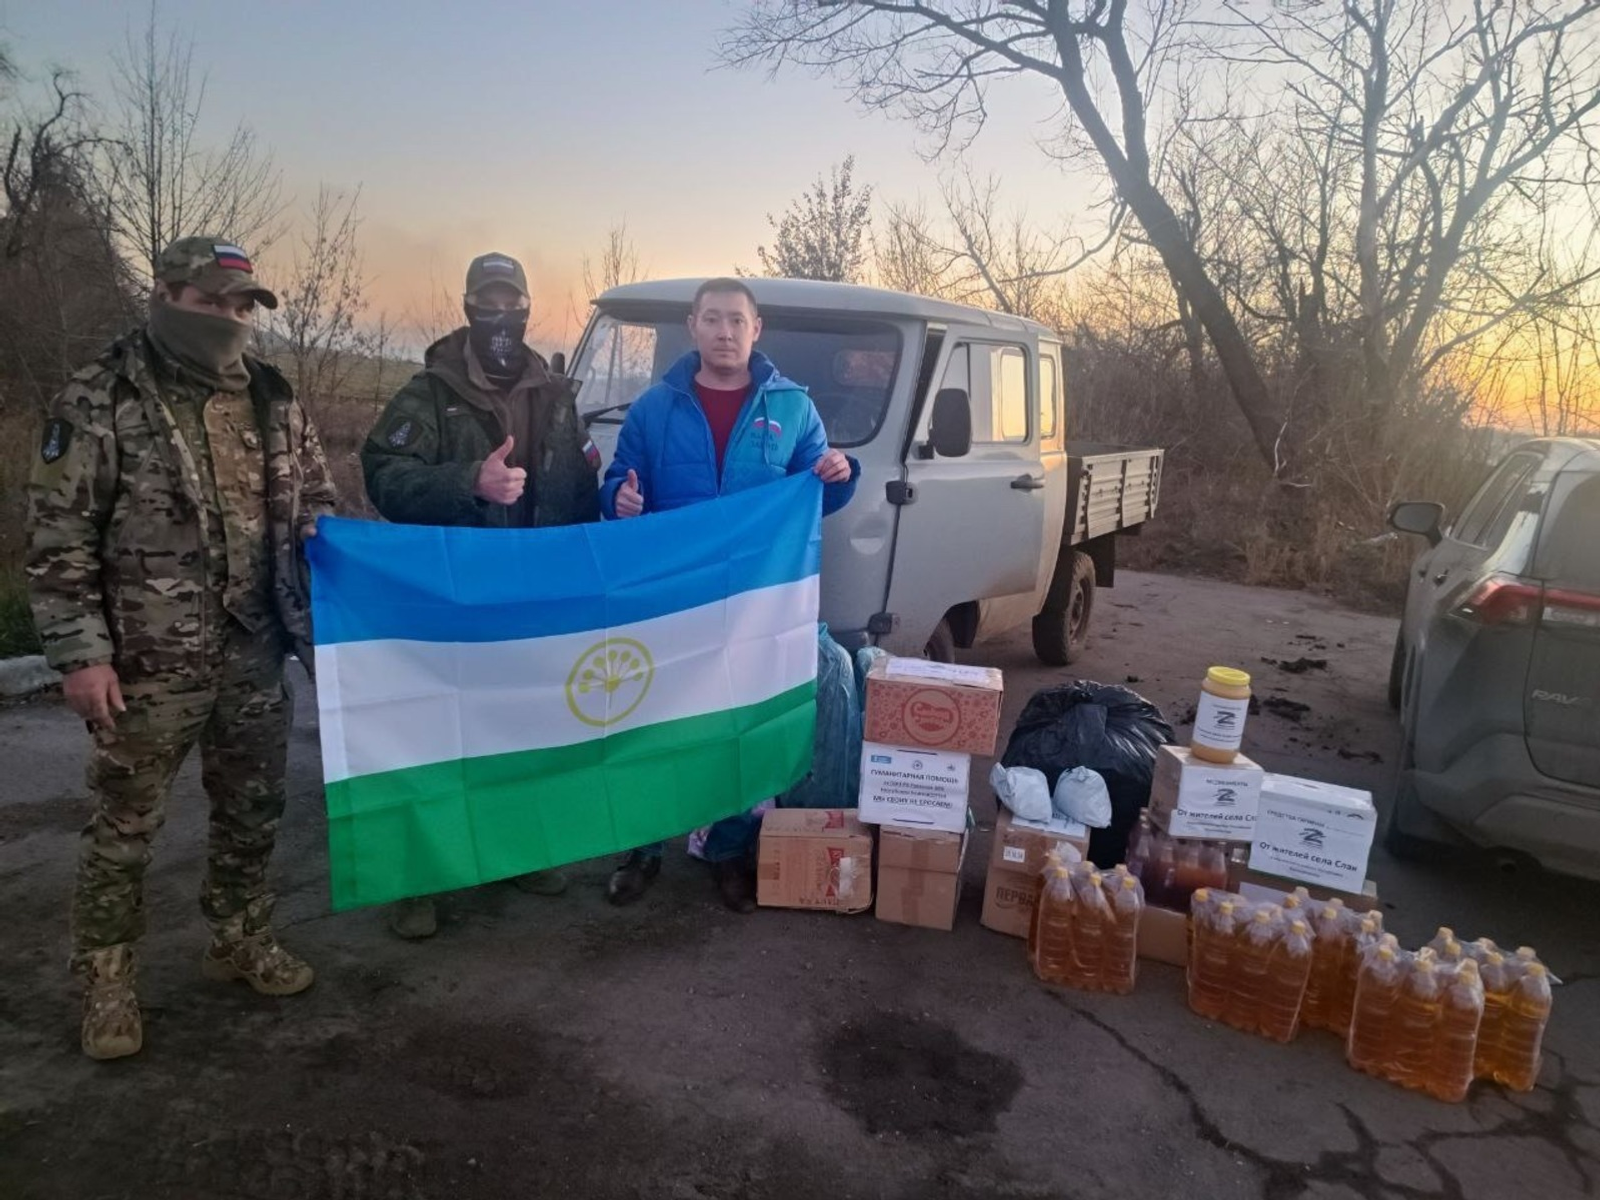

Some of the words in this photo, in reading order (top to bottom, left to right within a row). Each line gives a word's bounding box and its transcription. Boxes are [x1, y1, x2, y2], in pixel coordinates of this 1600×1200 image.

[871, 769, 924, 780] ГУМАНИТАРНАЯ
[1177, 808, 1188, 817] От
[1189, 811, 1223, 820] жителей
[1259, 841, 1270, 850] От
[1272, 844, 1309, 860] жителей
[1310, 855, 1332, 866] села
[996, 886, 1035, 906] ПЕРВА
